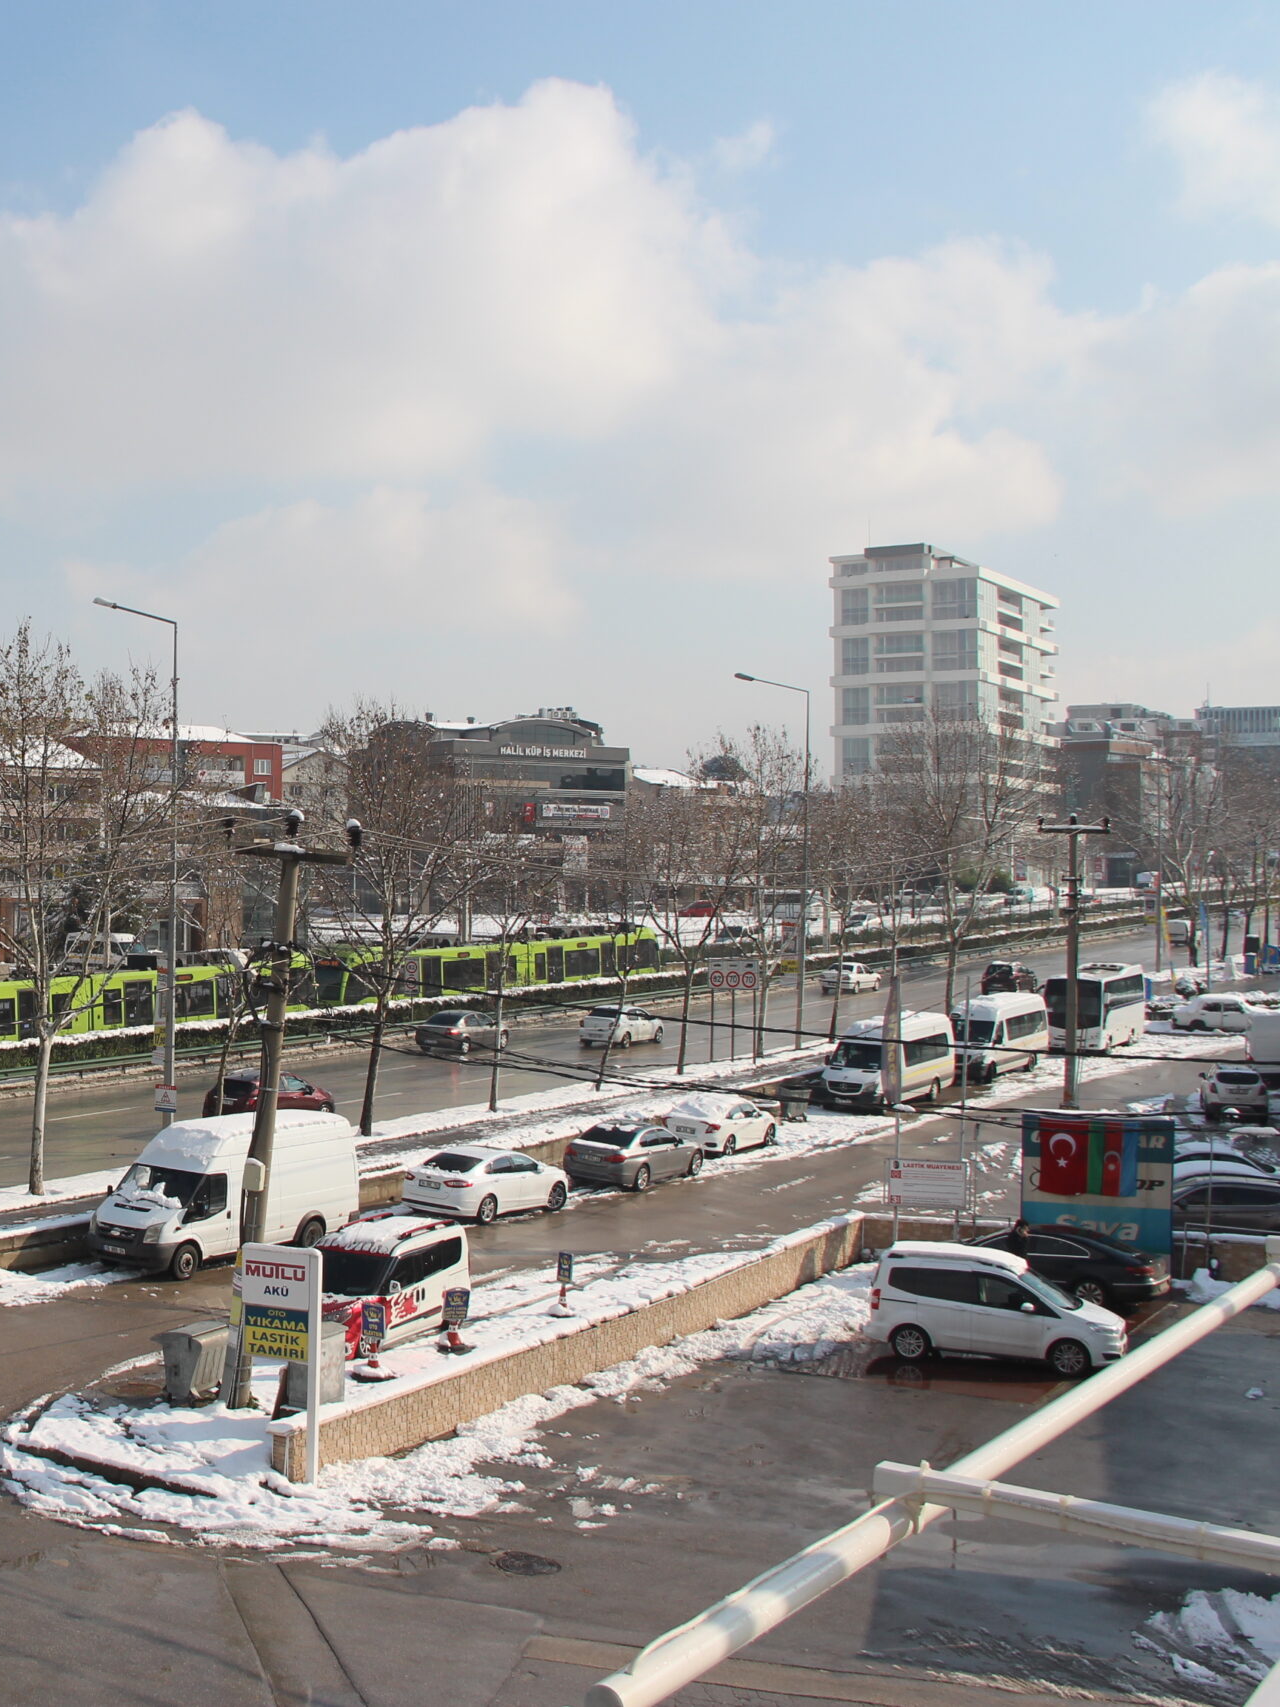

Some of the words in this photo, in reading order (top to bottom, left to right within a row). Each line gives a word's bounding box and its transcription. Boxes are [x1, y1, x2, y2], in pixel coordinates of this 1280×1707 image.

[500, 744, 524, 756] HALİL
[525, 745, 542, 756] KÜP
[543, 746, 551, 758] İŞ
[552, 748, 587, 758] MERKEZİ
[729, 975, 737, 983] 70
[745, 976, 753, 984] 70
[245, 1260, 306, 1282] MUTLU
[263, 1285, 289, 1297] AKÜ
[267, 1310, 286, 1318] OTO
[247, 1315, 306, 1332] YIKAMA
[252, 1330, 300, 1346] LASTİK
[248, 1342, 305, 1360] TAMİRİ
